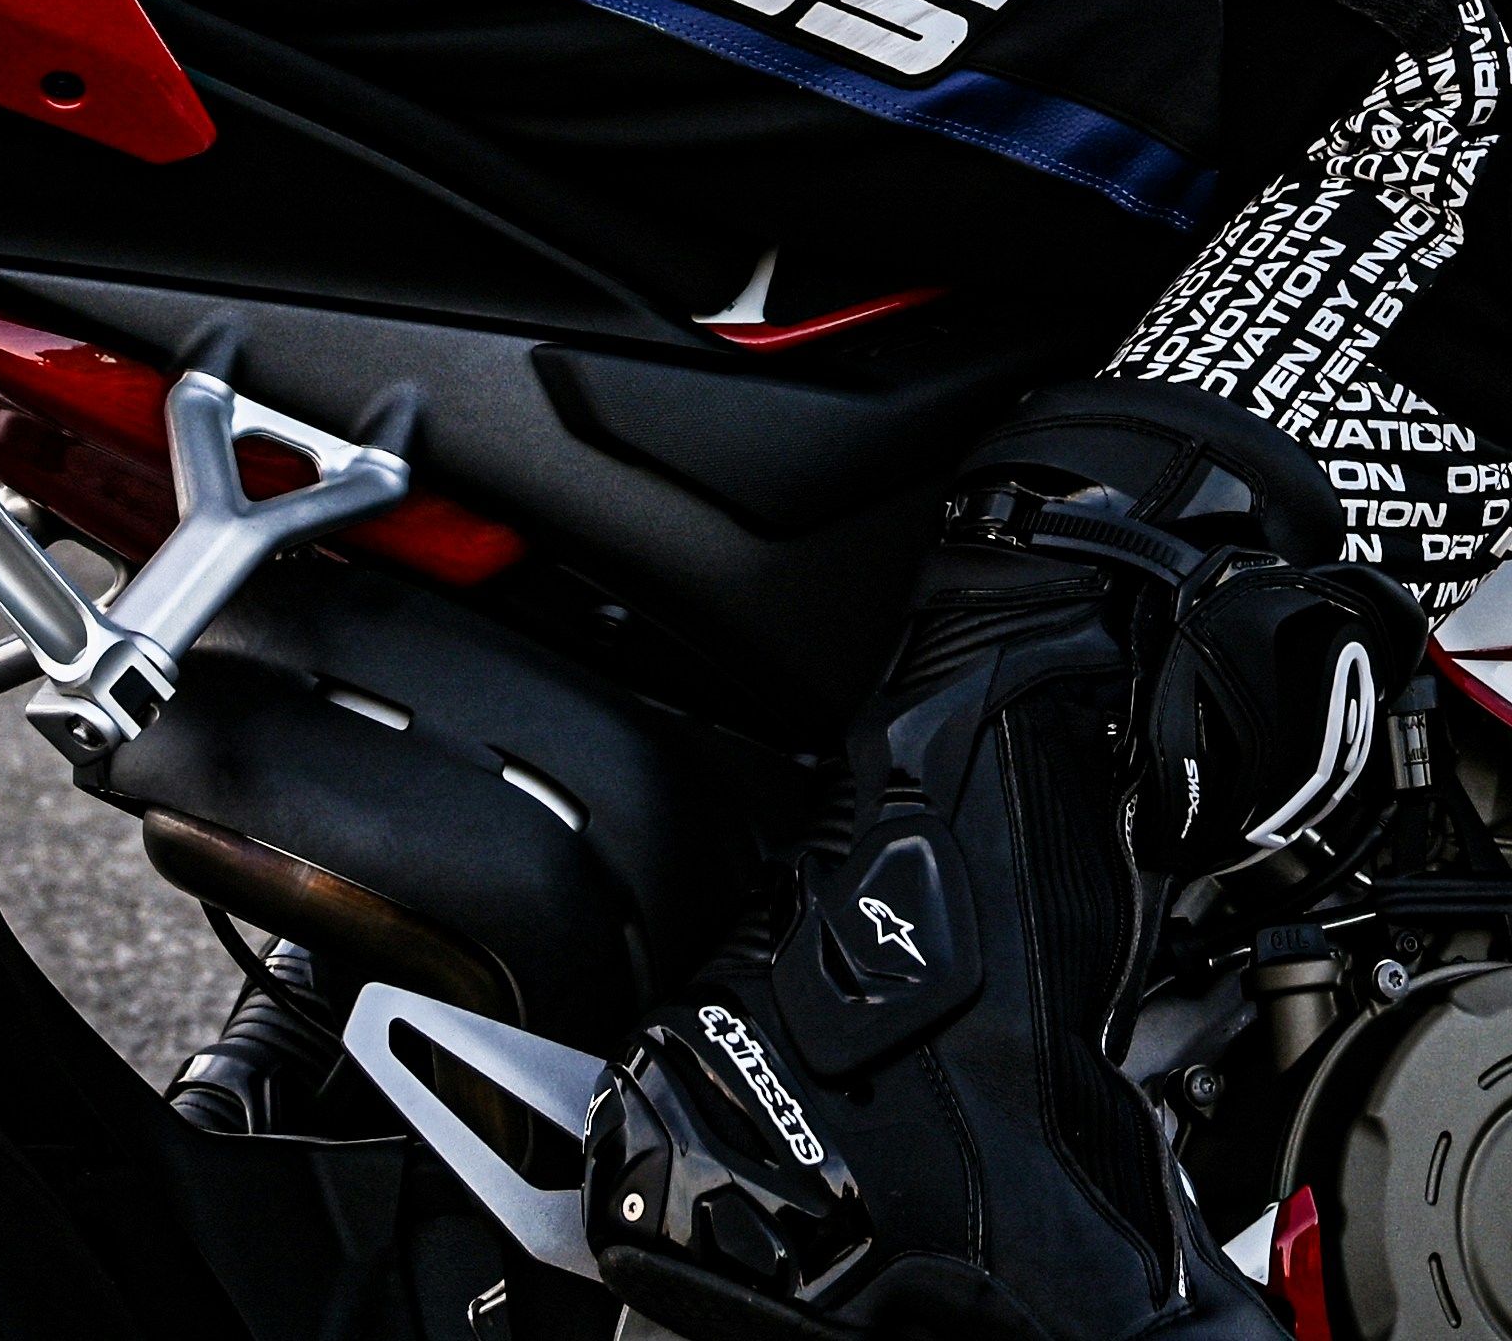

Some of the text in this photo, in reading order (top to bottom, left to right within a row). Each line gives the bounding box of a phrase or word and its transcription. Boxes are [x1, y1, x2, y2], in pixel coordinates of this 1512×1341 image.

[1304, 279, 1360, 343] BY
[1365, 262, 1420, 330] BY
[1317, 459, 1406, 492] ON
[1269, 928, 1310, 951] OIL
[698, 1005, 825, 1166] alpinestars
